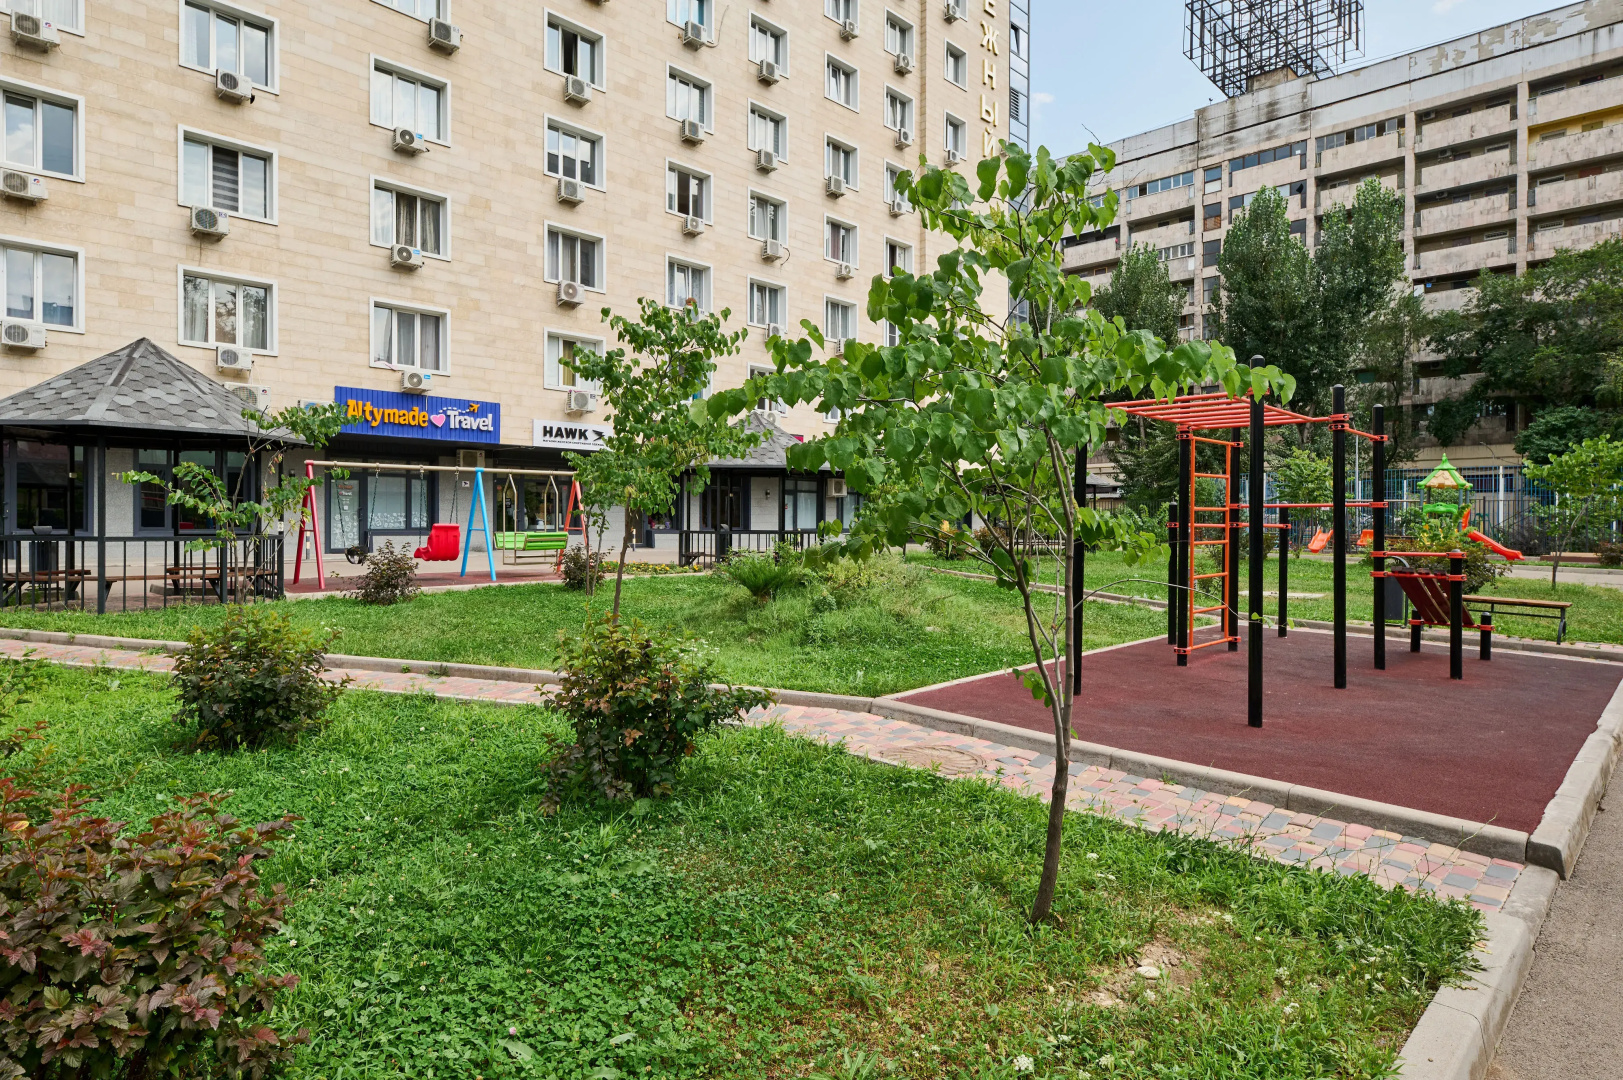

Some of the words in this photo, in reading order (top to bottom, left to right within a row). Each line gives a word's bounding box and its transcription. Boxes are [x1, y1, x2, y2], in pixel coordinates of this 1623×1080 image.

[347, 399, 429, 427] Altymade
[447, 410, 494, 432] Travel
[543, 425, 589, 440] HAWK
